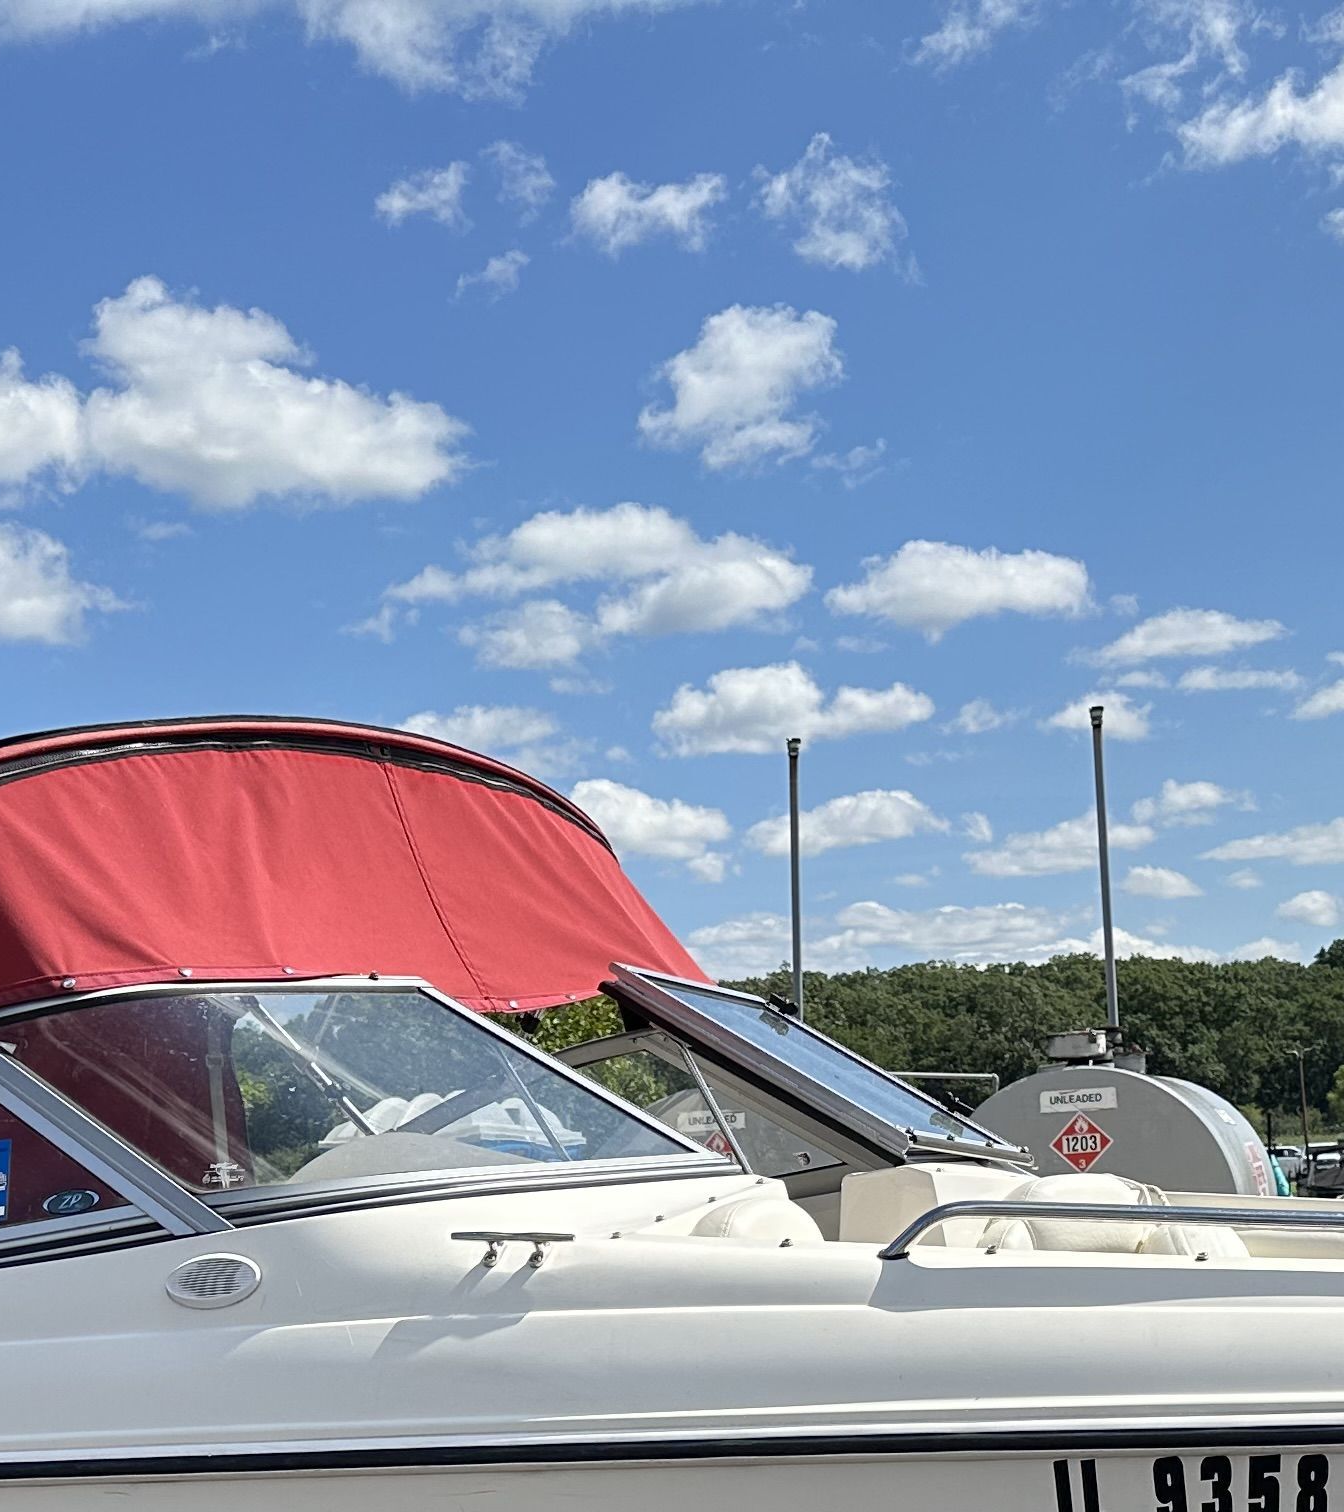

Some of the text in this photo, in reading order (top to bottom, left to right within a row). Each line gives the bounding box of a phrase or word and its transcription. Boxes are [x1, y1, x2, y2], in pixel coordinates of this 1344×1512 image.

[1049, 1093, 1103, 1105] UNLEADED
[688, 1114, 737, 1126] UNLEED
[1065, 1135, 1098, 1153] 1203
[1078, 1159, 1087, 1169] 3
